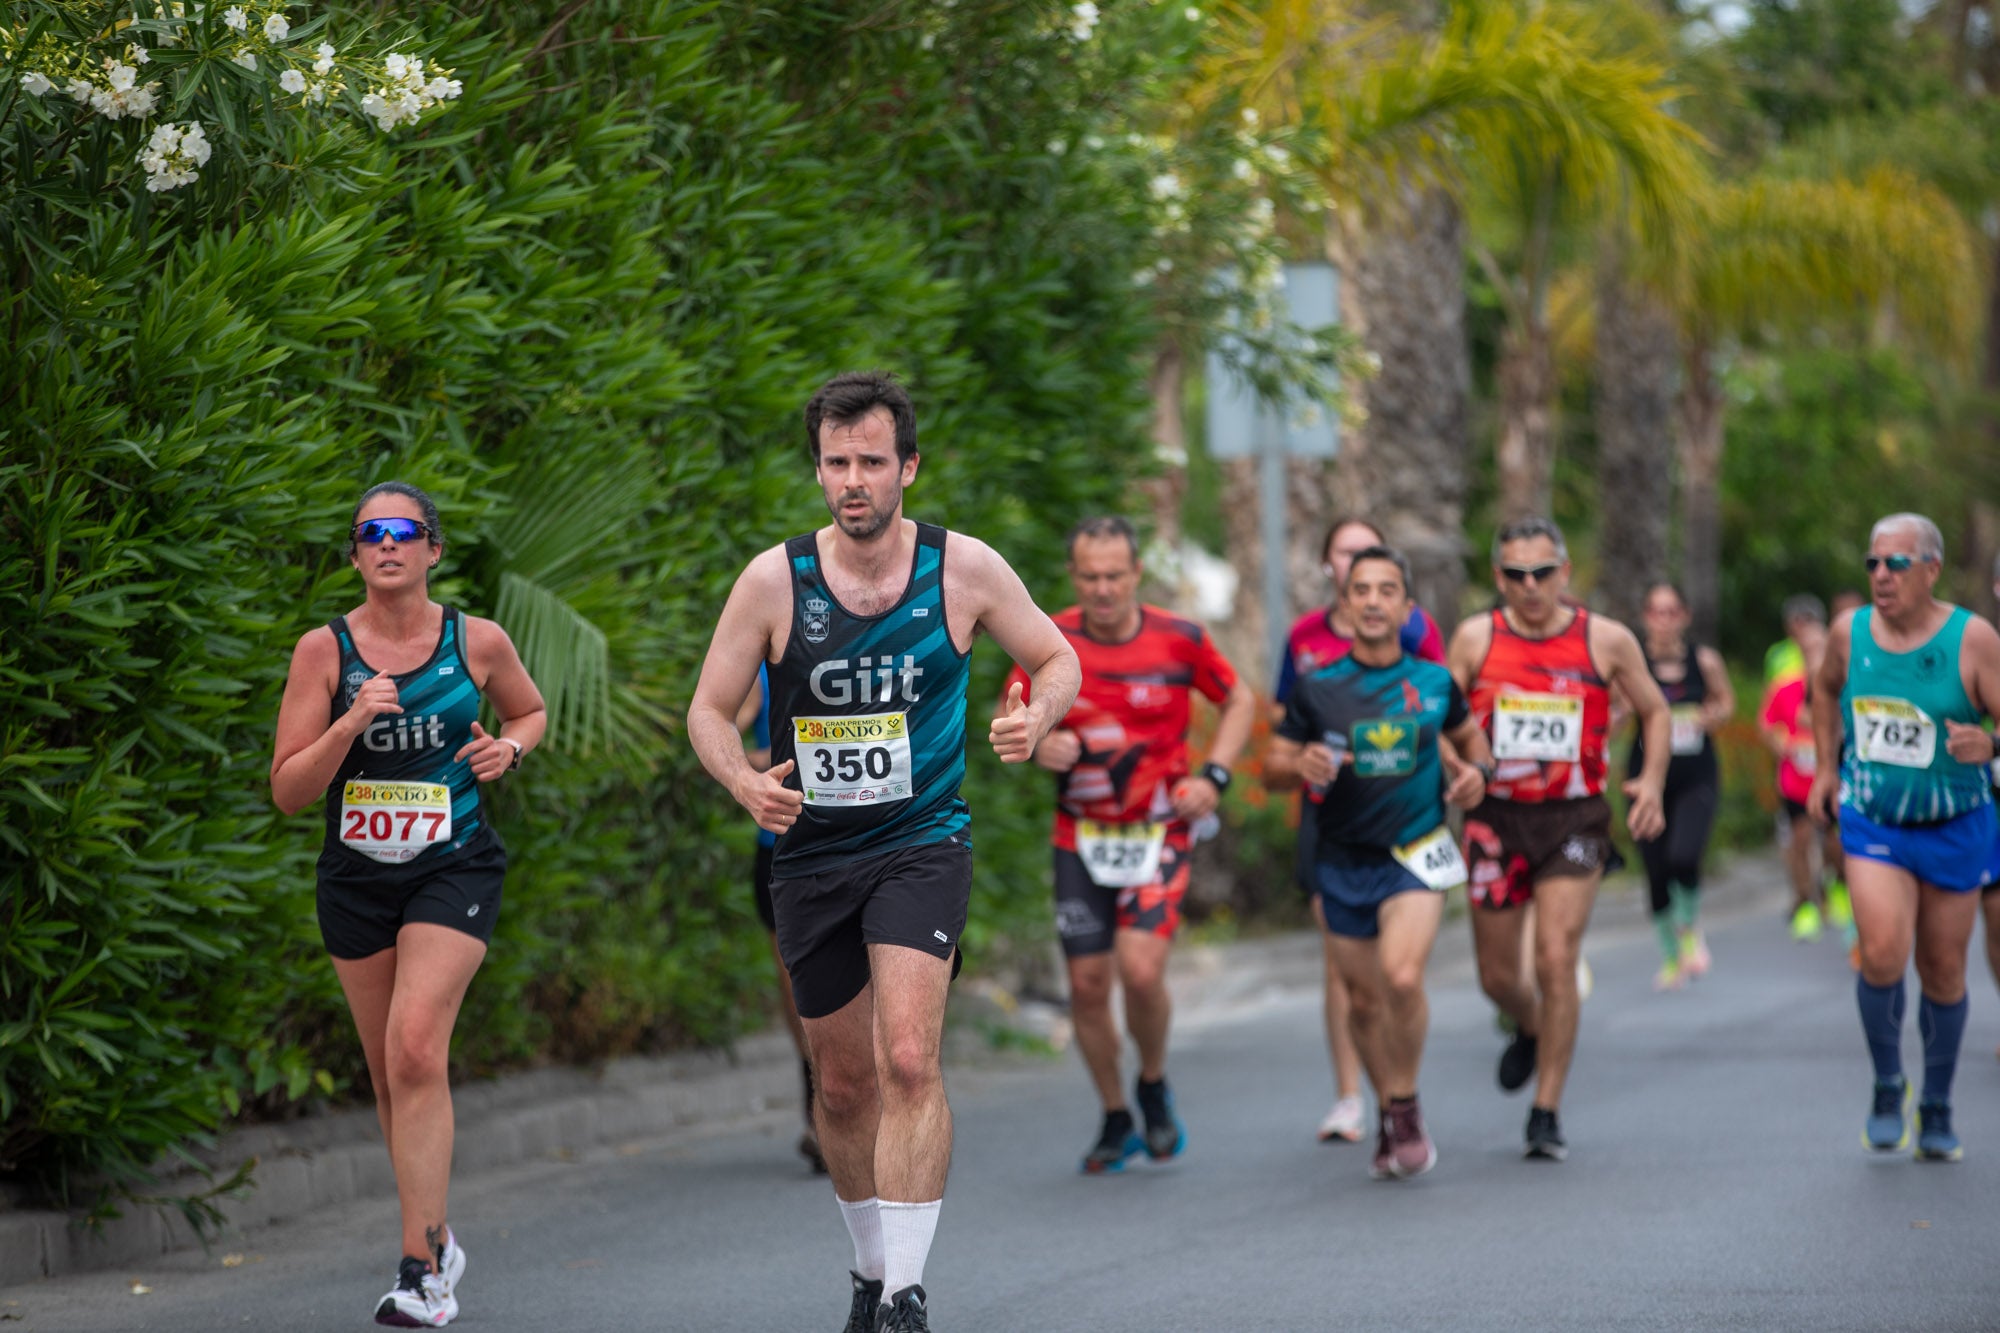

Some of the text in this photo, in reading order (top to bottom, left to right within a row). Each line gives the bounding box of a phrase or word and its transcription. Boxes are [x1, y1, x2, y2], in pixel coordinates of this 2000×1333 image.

[810, 655, 924, 705] Giit
[363, 714, 445, 752] Giit
[808, 722, 824, 737] 38
[824, 725, 883, 738] FONDO
[1511, 717, 1566, 743] 720
[1866, 717, 1921, 749] 762
[814, 746, 892, 783] 350
[355, 786, 372, 800] 38
[372, 790, 427, 801] FONDO
[343, 810, 446, 841] 2077
